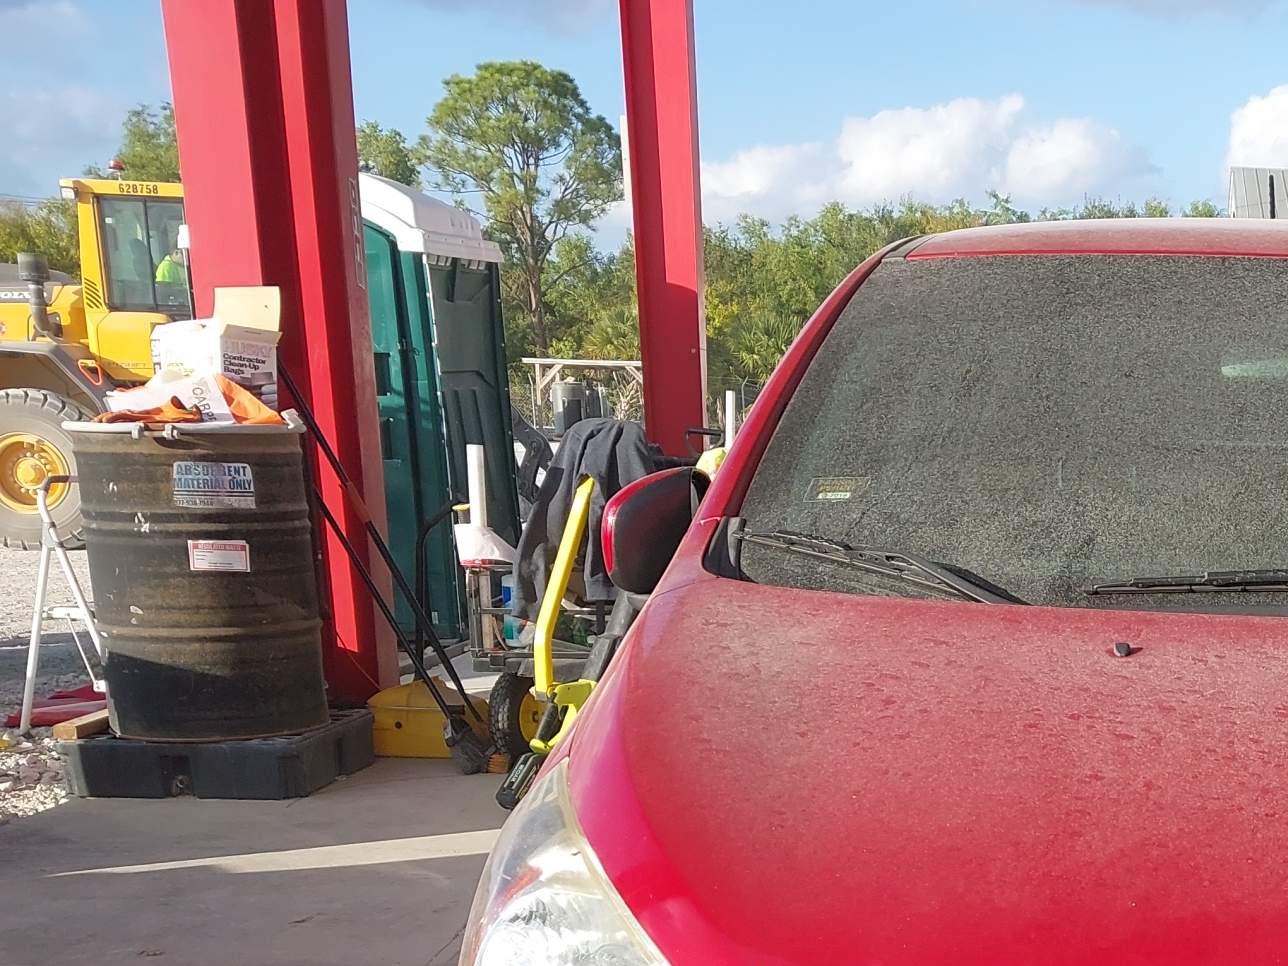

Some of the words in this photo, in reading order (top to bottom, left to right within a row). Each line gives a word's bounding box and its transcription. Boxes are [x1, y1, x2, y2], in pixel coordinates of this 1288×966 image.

[118, 183, 159, 194] 628758
[222, 352, 266, 365] Contractor
[223, 366, 245, 376] Bags
[228, 478, 252, 490] ONLY
